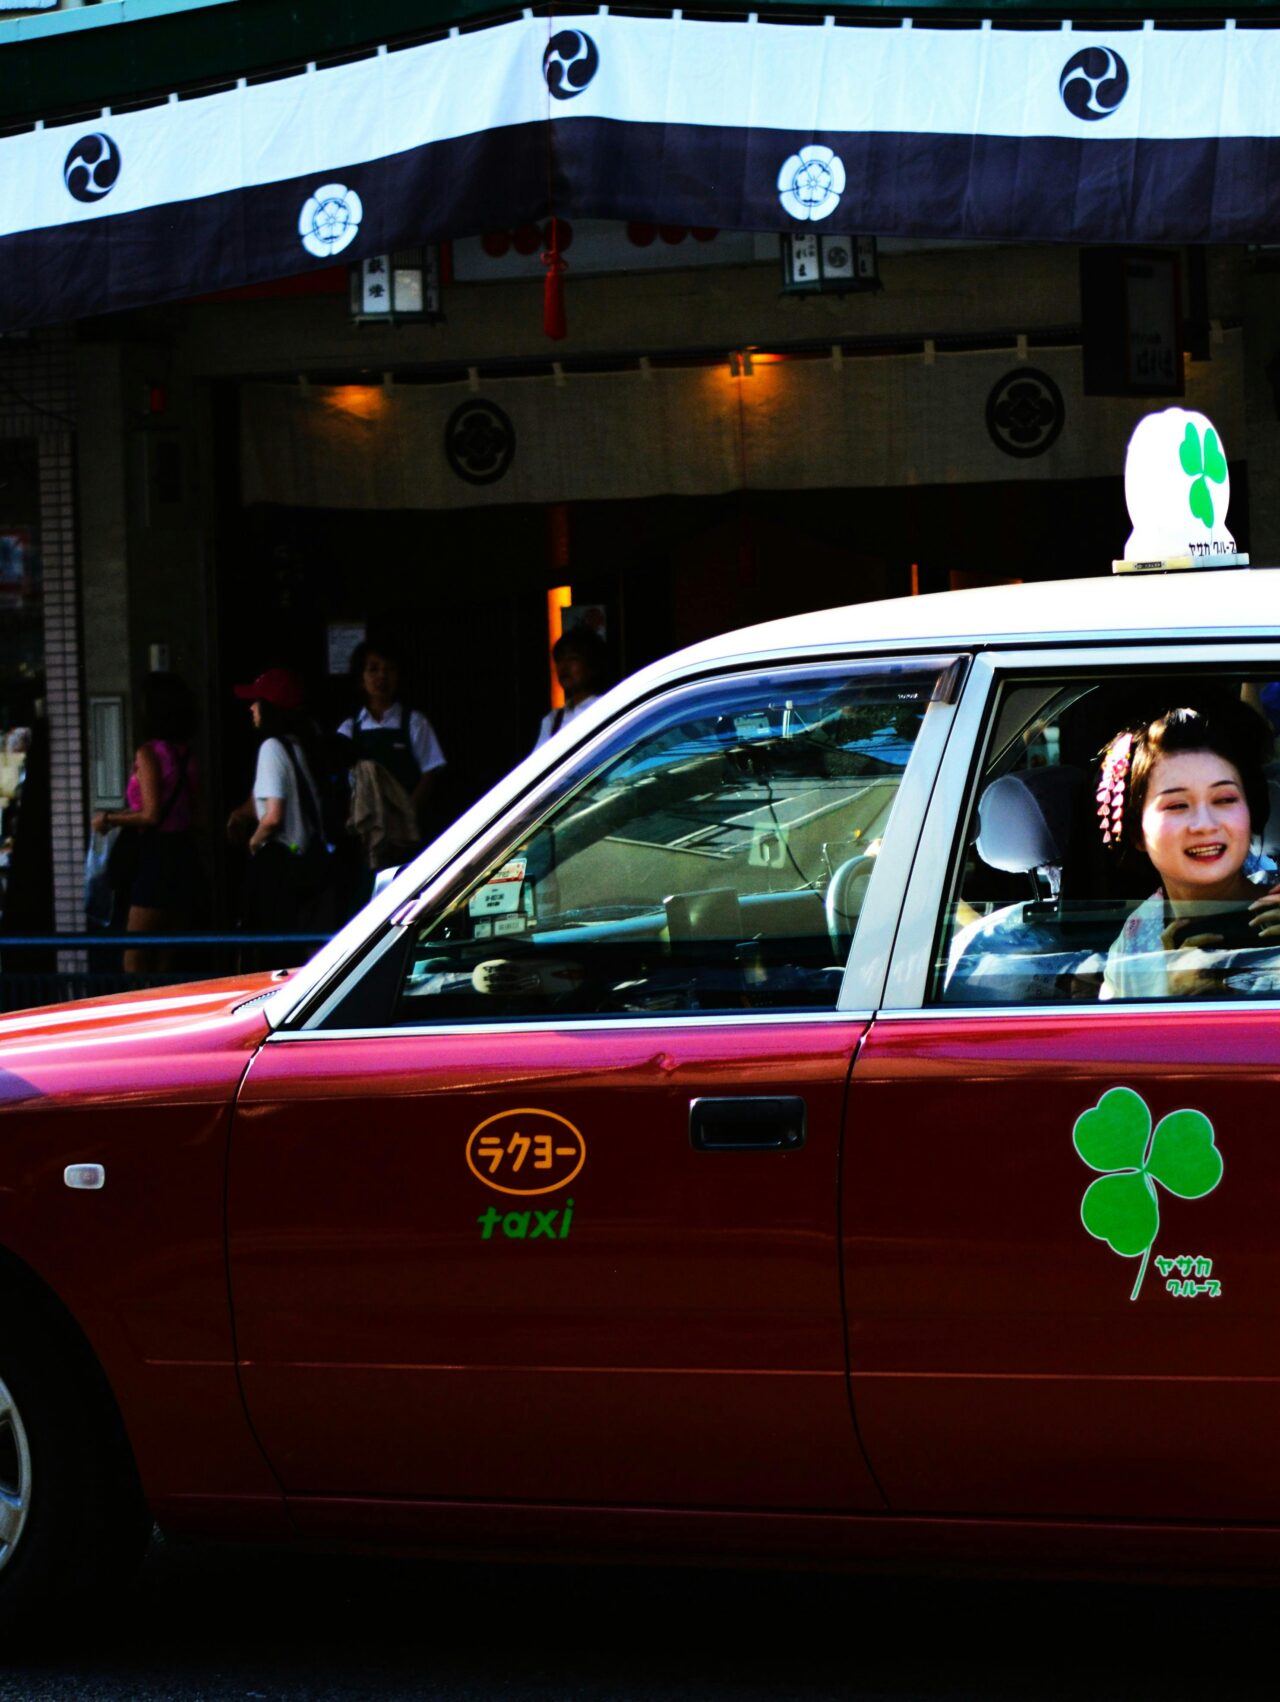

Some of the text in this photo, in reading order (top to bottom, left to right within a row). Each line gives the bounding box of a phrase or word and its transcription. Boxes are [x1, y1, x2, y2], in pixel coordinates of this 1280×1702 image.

[478, 1132, 577, 1174] ラクヨー
[477, 1198, 575, 1240] taxi
[1154, 1255, 1213, 1278] ヤサカ
